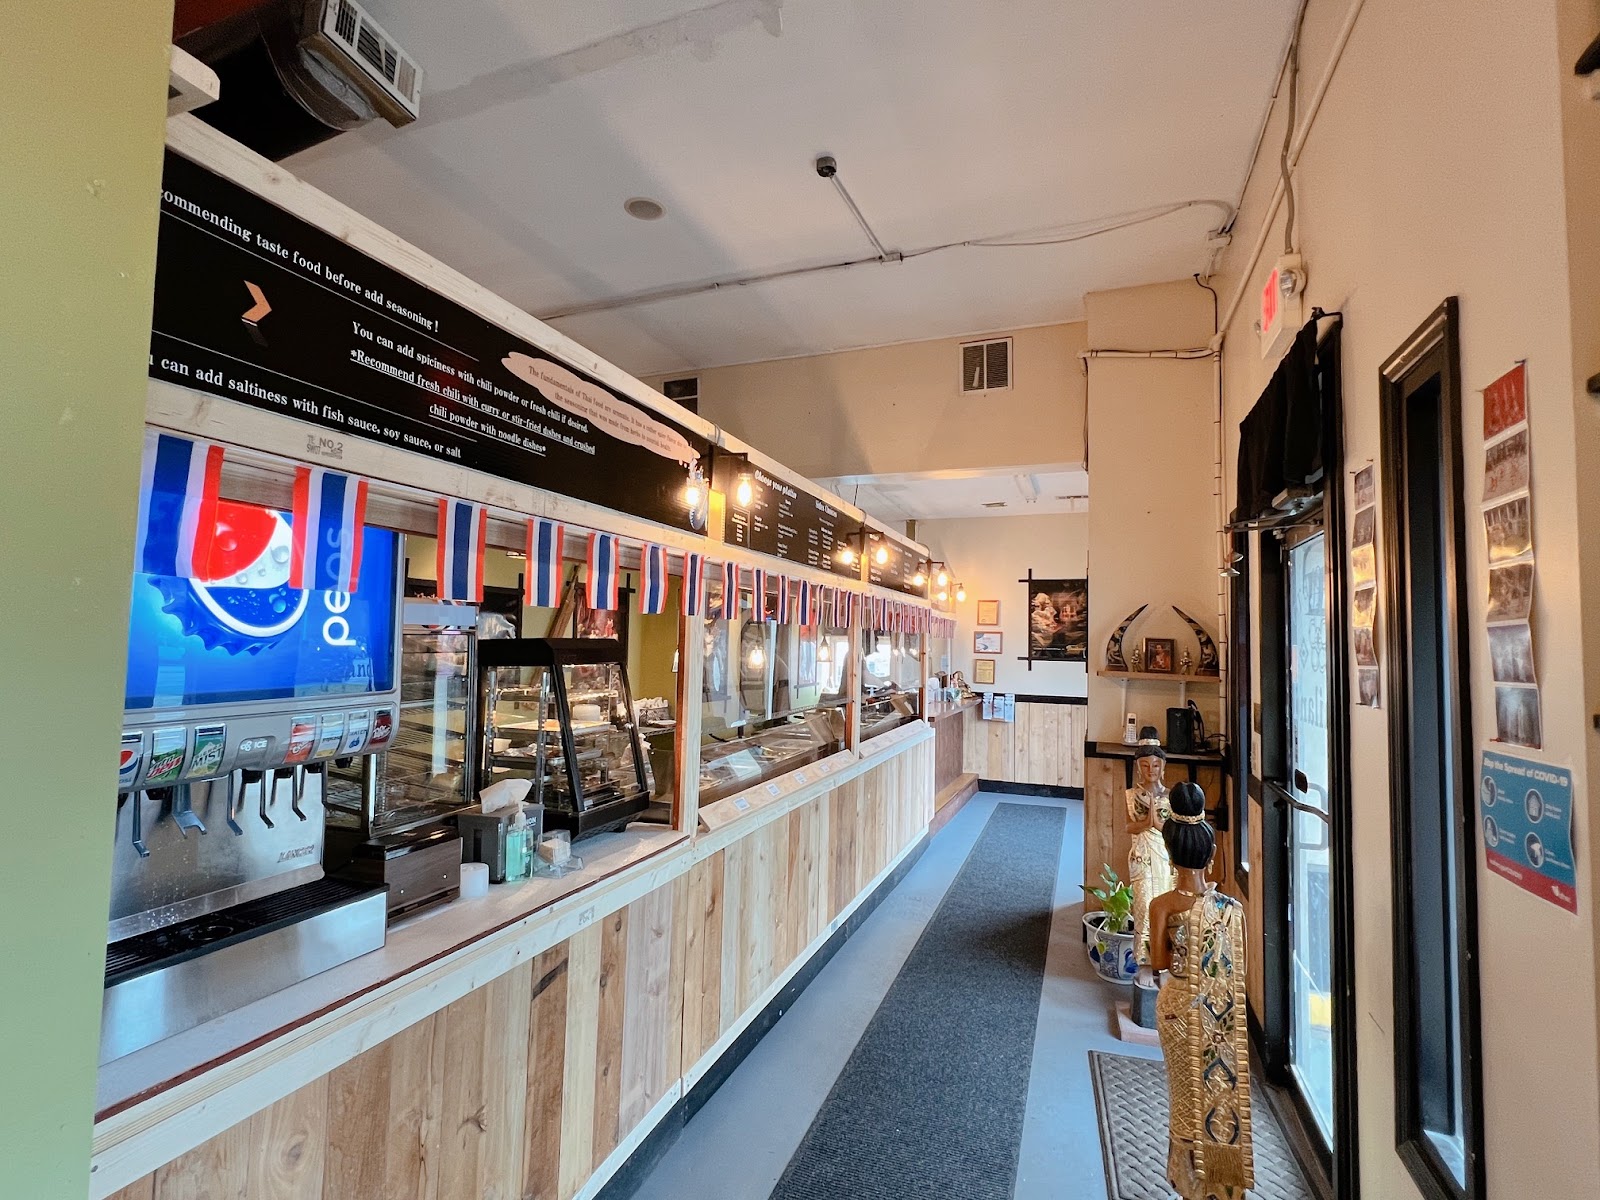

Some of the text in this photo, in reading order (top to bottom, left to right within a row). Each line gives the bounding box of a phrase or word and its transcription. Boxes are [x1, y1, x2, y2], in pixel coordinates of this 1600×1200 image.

[160, 188, 252, 242] ommending
[256, 233, 289, 259] taste
[292, 250, 321, 275] food
[325, 266, 362, 294] before
[364, 289, 384, 306] add
[353, 320, 589, 434] You can add spiciness with chili powder or fresh chili if desired.
[528, 365, 539, 377] The
[575, 390, 581, 398] of
[582, 392, 593, 403] Thai
[160, 357, 190, 377] can
[195, 368, 224, 387] add
[228, 378, 288, 406] saltiness
[292, 398, 319, 416] with
[322, 404, 345, 424] fish
[347, 414, 381, 435] sauce,
[383, 425, 401, 441] soy
[403, 431, 432, 451] sauce,
[434, 443, 444, 454] or
[446, 445, 462, 459] salt
[417, 374, 440, 394] fresh
[442, 385, 461, 401] chili
[462, 393, 479, 408] with
[480, 402, 500, 417] curry
[502, 410, 510, 420] or
[511, 414, 542, 433] stir-fried
[542, 426, 561, 440] dishes
[562, 434, 574, 446] and
[574, 439, 596, 456] crushed
[429, 403, 447, 419] chili
[449, 412, 479, 431] powder
[480, 423, 497, 437] with
[498, 430, 521, 445] noodle
[191, 747, 225, 771] MIST
[253, 740, 268, 749] ICE
[1494, 760, 1504, 771] the
[1503, 762, 1526, 775] Spread
[1526, 768, 1534, 778] of
[1534, 770, 1568, 787] COVID-19
